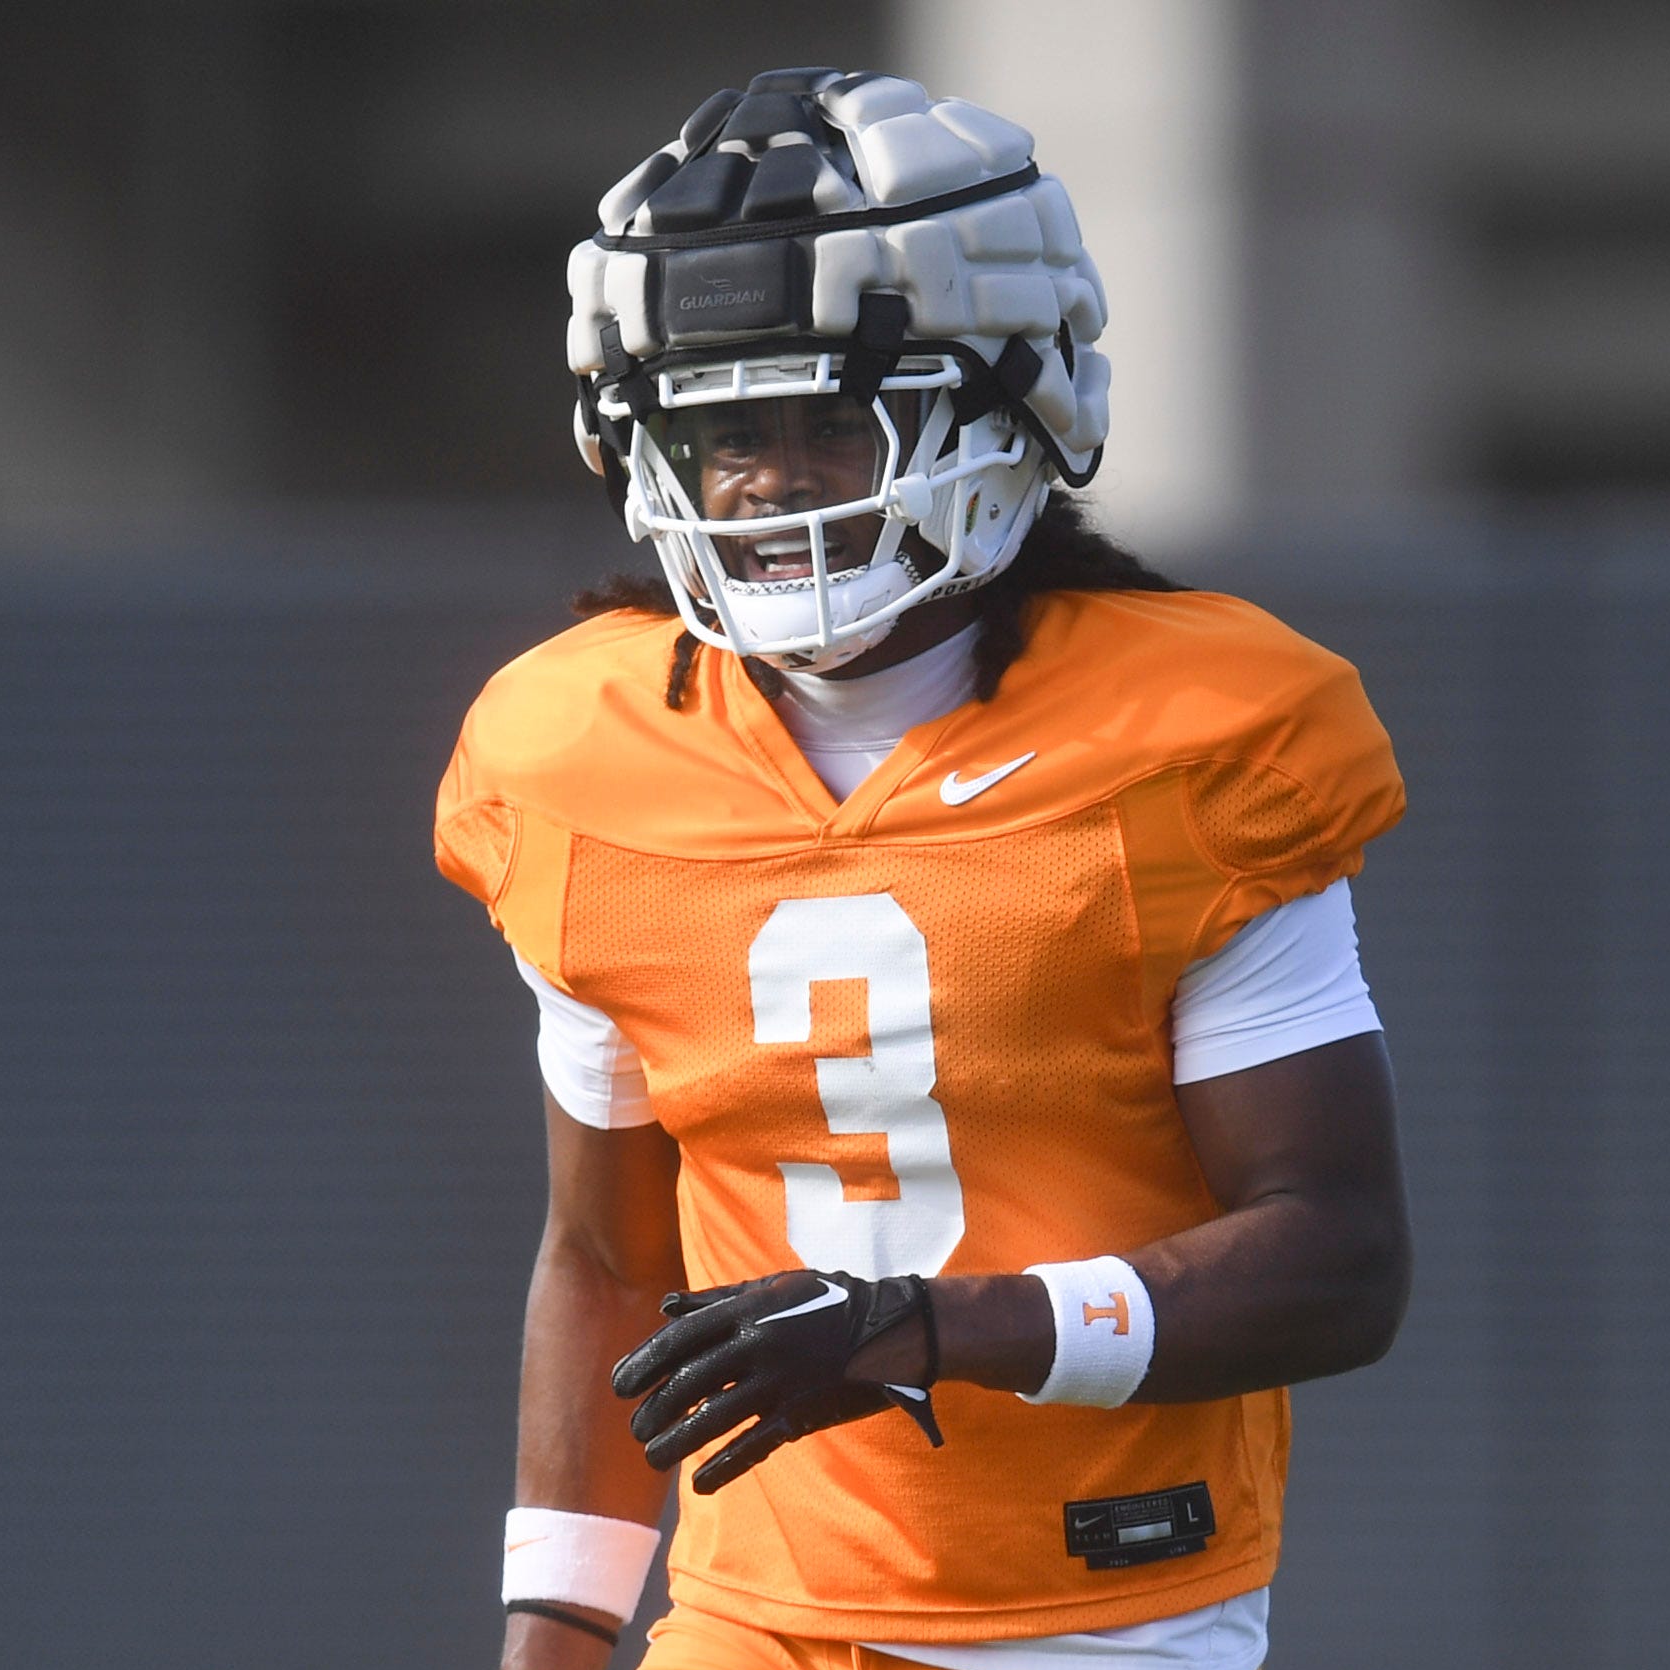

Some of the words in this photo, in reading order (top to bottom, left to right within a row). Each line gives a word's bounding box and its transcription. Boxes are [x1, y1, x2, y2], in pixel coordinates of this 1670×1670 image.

[679, 290, 766, 310] GUARDIAN
[748, 893, 965, 1280] 3
[1082, 1292, 1130, 1336] T
[1186, 1502, 1199, 1523] L
